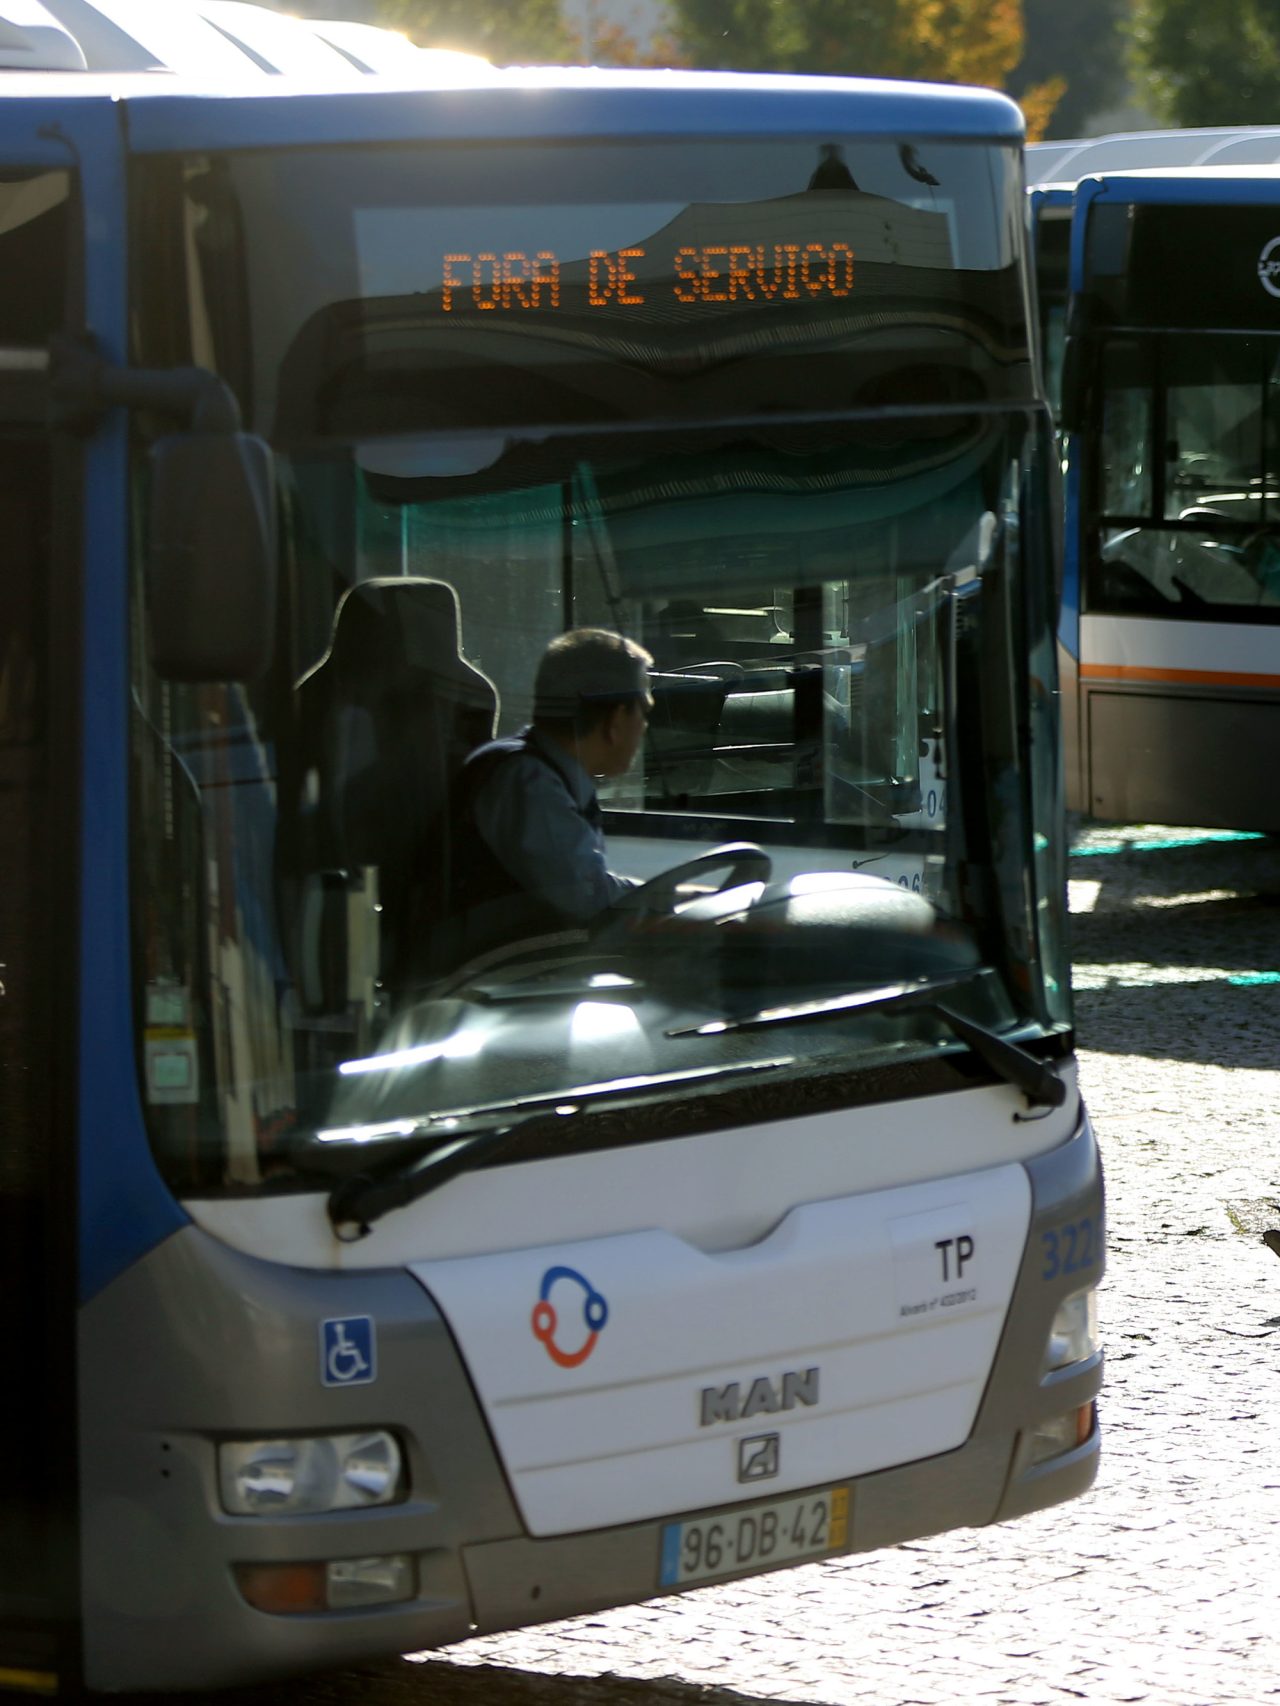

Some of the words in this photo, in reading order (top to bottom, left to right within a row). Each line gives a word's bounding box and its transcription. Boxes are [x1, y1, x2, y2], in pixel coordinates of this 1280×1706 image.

[443, 252, 561, 312] FORA
[588, 249, 646, 306] DE
[934, 1234, 975, 1282] TP
[1041, 1216, 1104, 1281] 322
[700, 1367, 820, 1426] MAN
